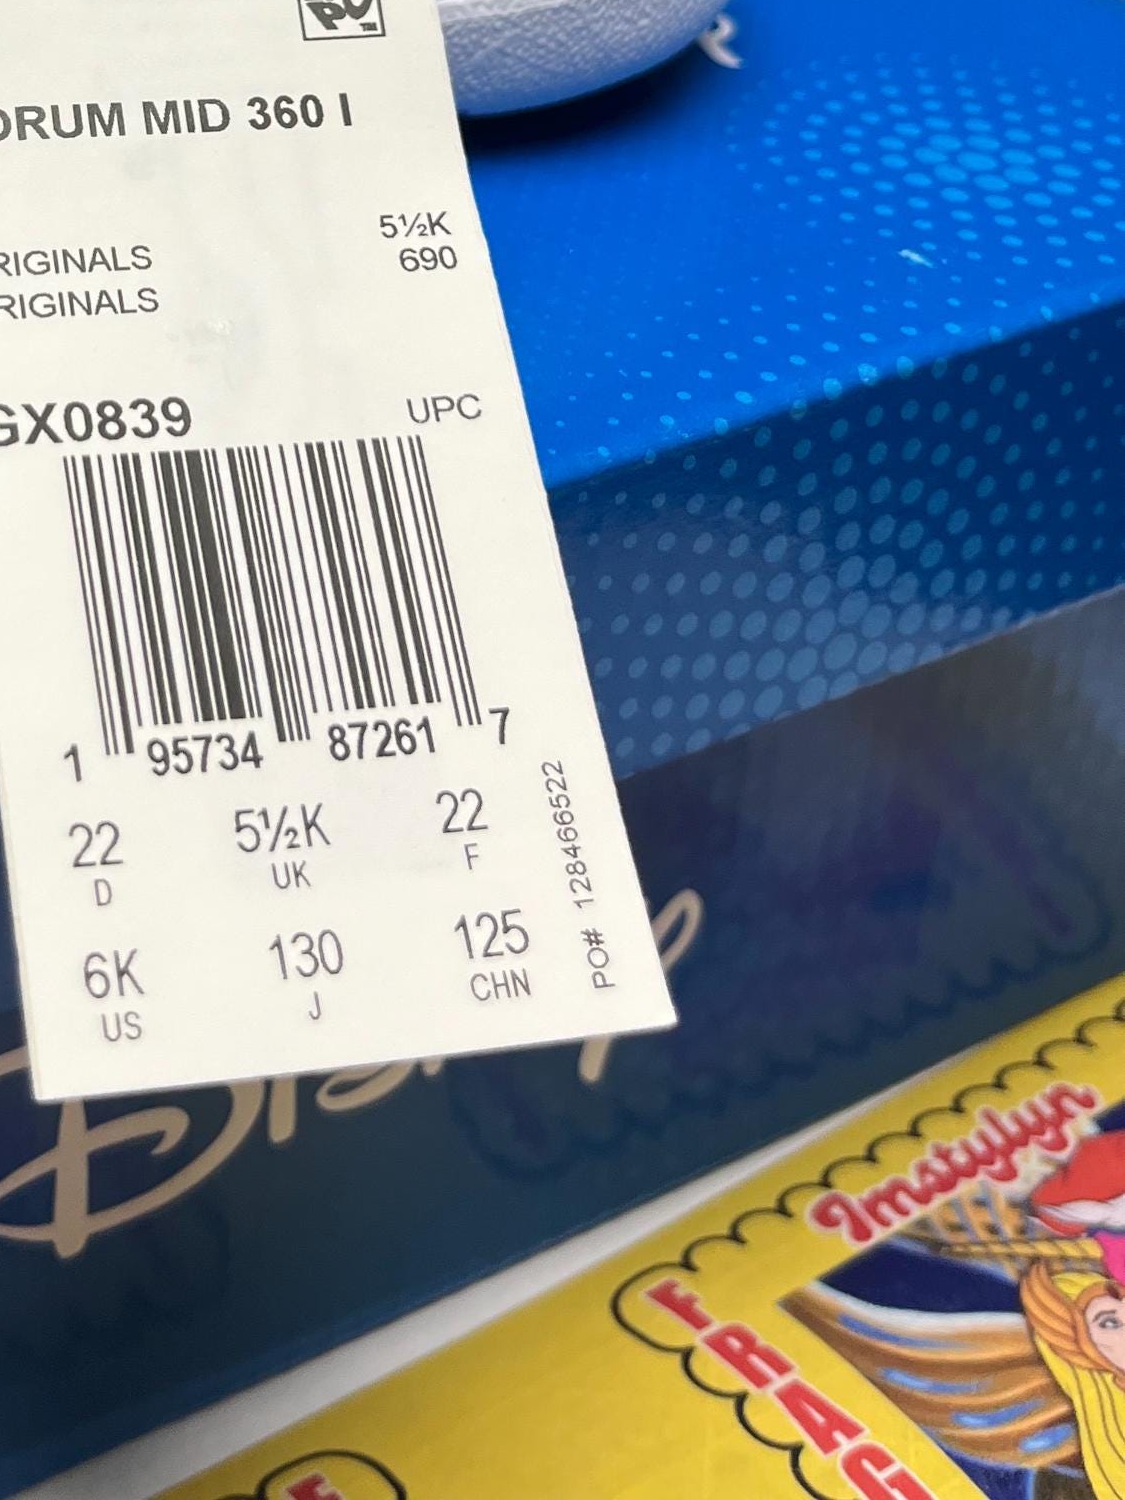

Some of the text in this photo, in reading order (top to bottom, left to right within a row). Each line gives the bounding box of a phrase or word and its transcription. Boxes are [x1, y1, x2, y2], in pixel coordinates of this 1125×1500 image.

[142, 99, 230, 135] MID
[247, 95, 324, 130] 360
[399, 246, 457, 272] 690
[407, 394, 481, 424] UPC
[64, 707, 509, 782] 1 95734 87261 7
[436, 788, 488, 833] 22
[69, 821, 123, 868] 22
[464, 843, 478, 870] F
[94, 879, 112, 906] D
[272, 861, 311, 889] UK
[541, 761, 615, 988] PO# 128466522
[455, 909, 529, 959] 125
[269, 930, 343, 980] 130
[84, 949, 144, 999] 6K
[470, 968, 531, 1001] CHN
[309, 992, 321, 1020] J
[101, 1011, 142, 1042] US
